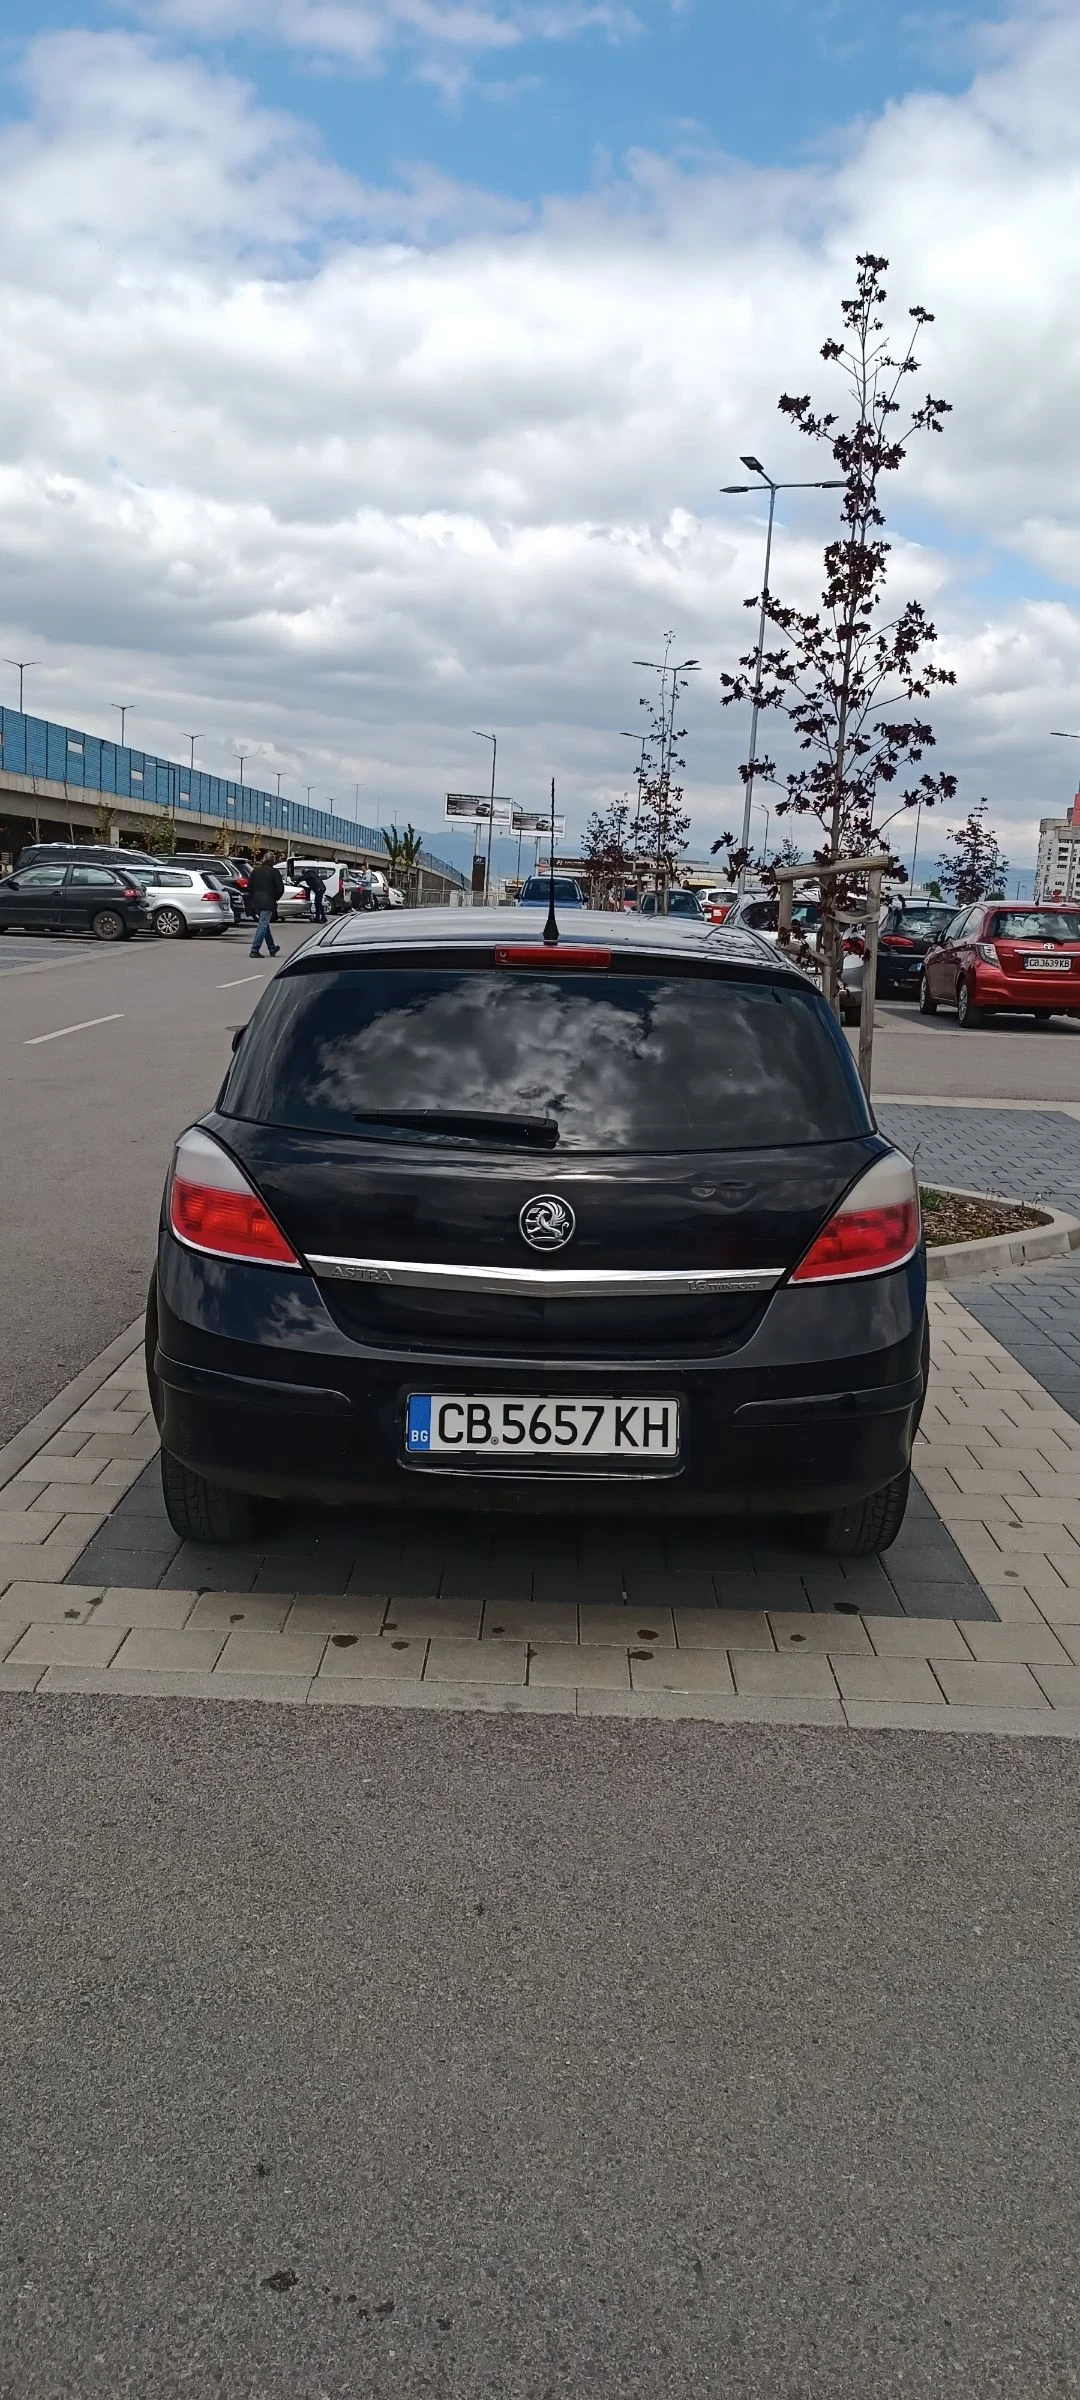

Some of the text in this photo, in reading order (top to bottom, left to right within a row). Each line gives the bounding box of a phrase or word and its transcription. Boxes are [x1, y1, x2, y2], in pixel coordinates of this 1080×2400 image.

[331, 1266, 393, 1282] ASTRA
[438, 1403, 669, 1448] CB 5657 KH
[411, 1430, 429, 1442] BG
